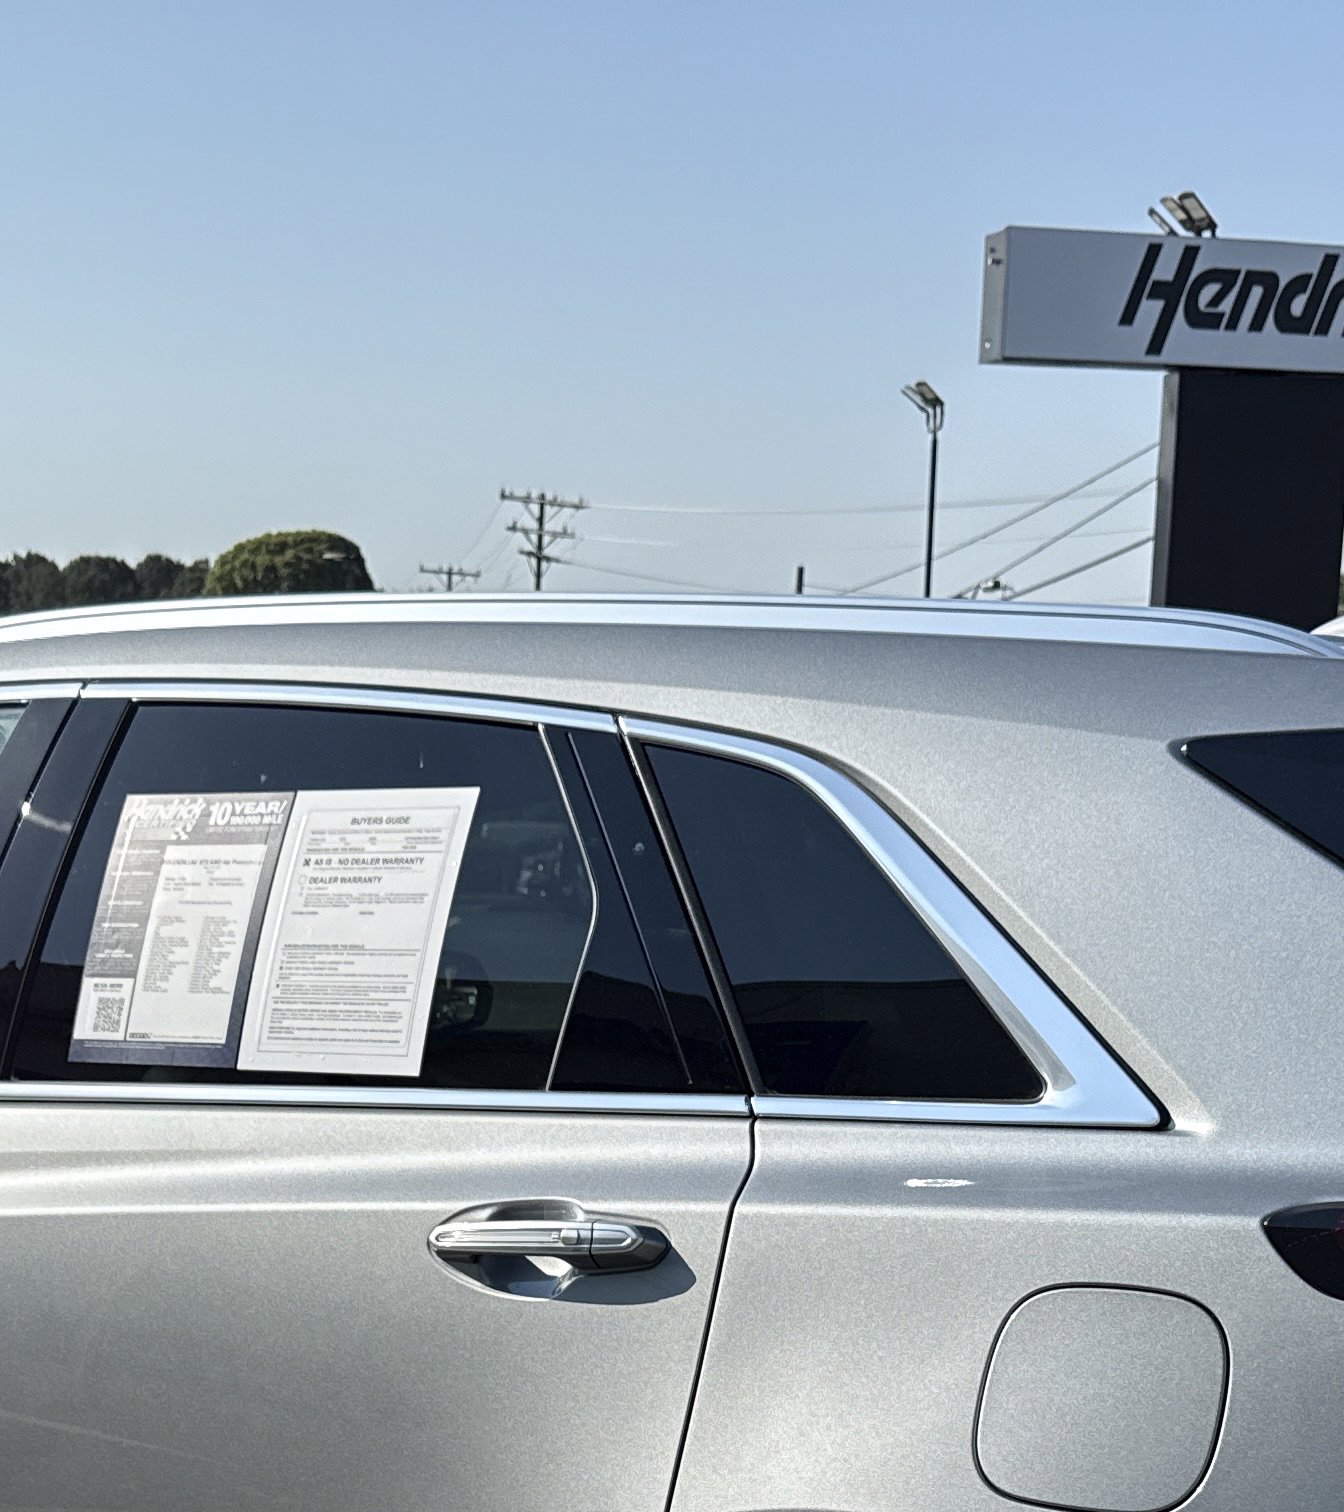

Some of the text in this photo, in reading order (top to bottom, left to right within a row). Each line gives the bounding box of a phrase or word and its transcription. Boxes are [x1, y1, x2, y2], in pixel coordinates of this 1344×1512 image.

[208, 801, 234, 826] 10
[350, 816, 411, 826] BUYERS GUIDE
[338, 858, 349, 866] NO
[350, 857, 380, 866] DEALER
[382, 857, 425, 865] WARRANTY
[308, 876, 383, 885] DEALER WARRANTY
